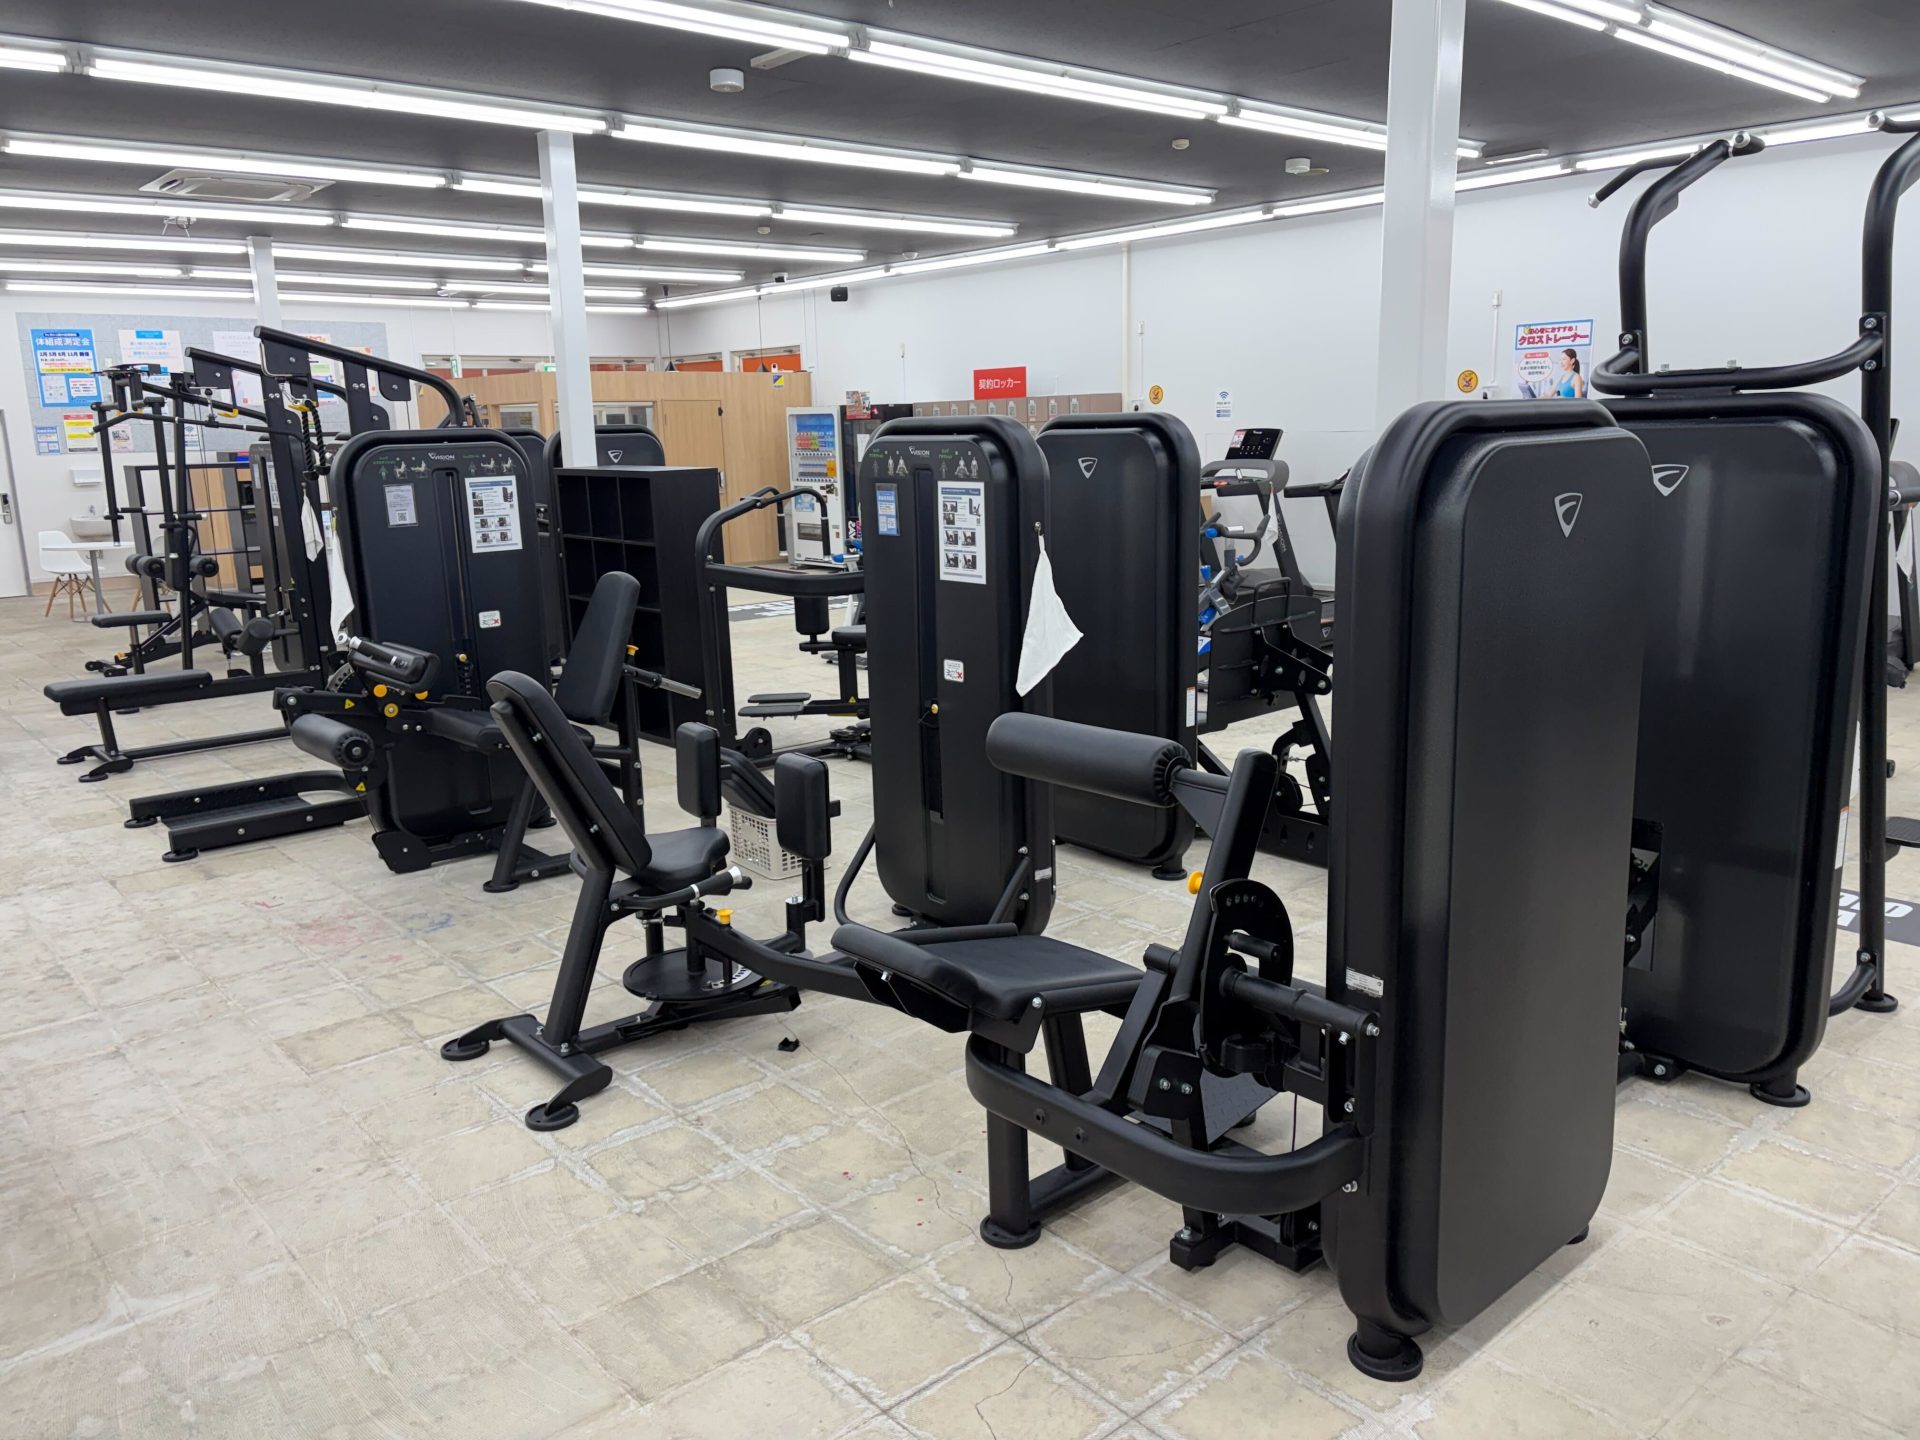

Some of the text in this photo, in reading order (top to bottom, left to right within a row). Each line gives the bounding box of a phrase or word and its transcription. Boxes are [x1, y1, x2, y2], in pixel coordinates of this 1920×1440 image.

[1518, 332, 1589, 346] クロストレーナー
[978, 378, 1021, 390] 契約ロッカー
